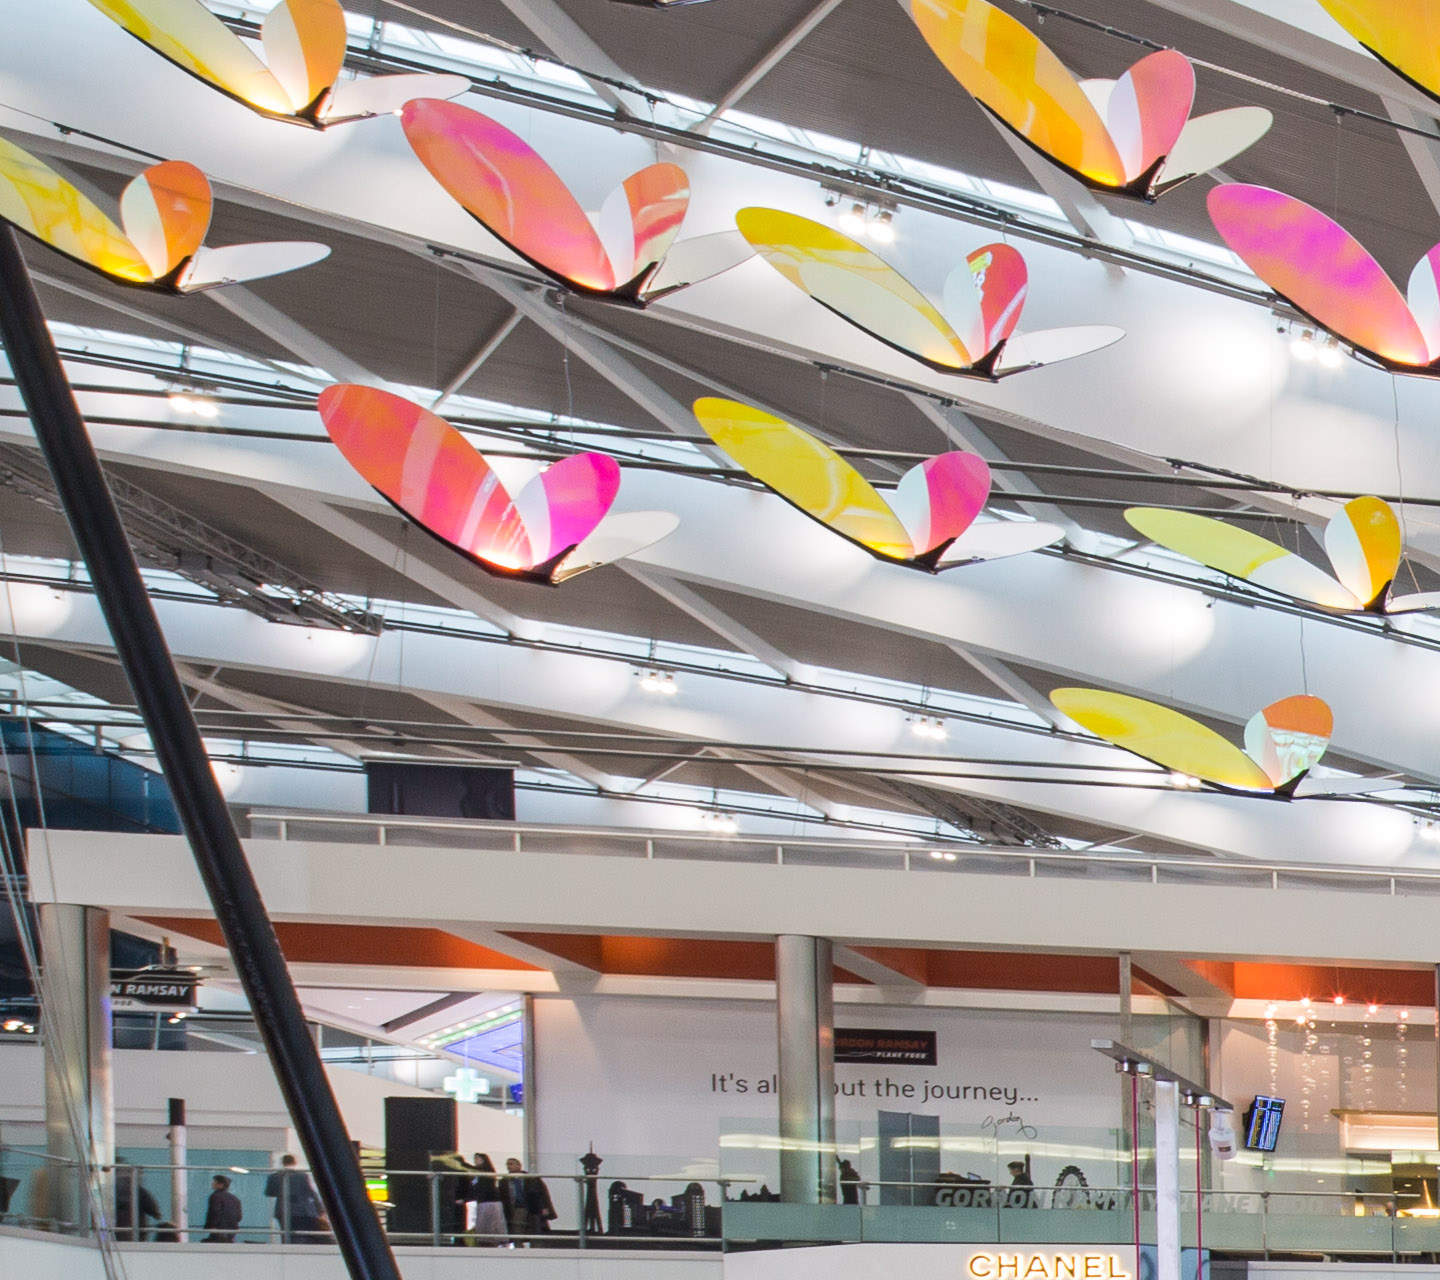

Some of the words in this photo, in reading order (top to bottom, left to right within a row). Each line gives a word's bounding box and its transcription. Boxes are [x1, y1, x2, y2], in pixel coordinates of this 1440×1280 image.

[126, 983, 189, 997] RAMSAY
[711, 1073, 748, 1093] It's
[875, 1078, 915, 1098] the
[921, 1080, 1039, 1105] journey...
[935, 1187, 1051, 1210] GORDON
[968, 1253, 1128, 1280] CHANEL
